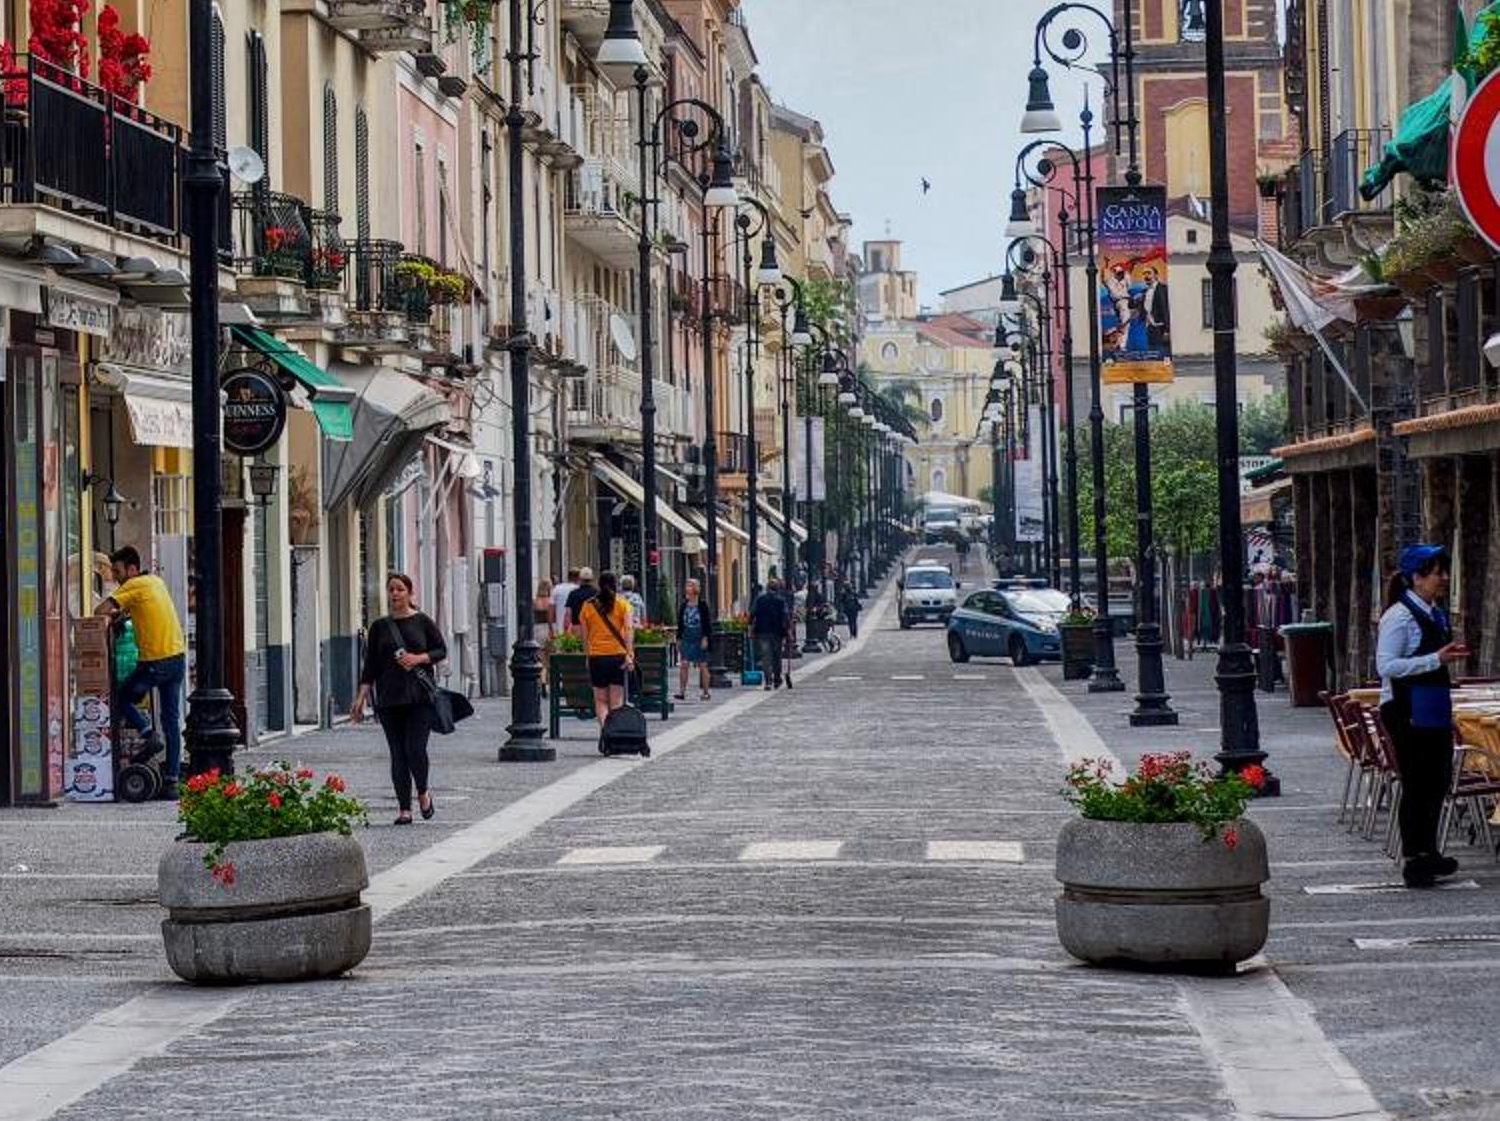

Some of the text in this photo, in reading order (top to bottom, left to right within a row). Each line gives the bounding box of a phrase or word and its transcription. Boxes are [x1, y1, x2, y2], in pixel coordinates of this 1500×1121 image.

[1105, 204, 1161, 218] CANTA
[1102, 217, 1162, 230] NAPOLI
[225, 404, 277, 417] UINNESS
